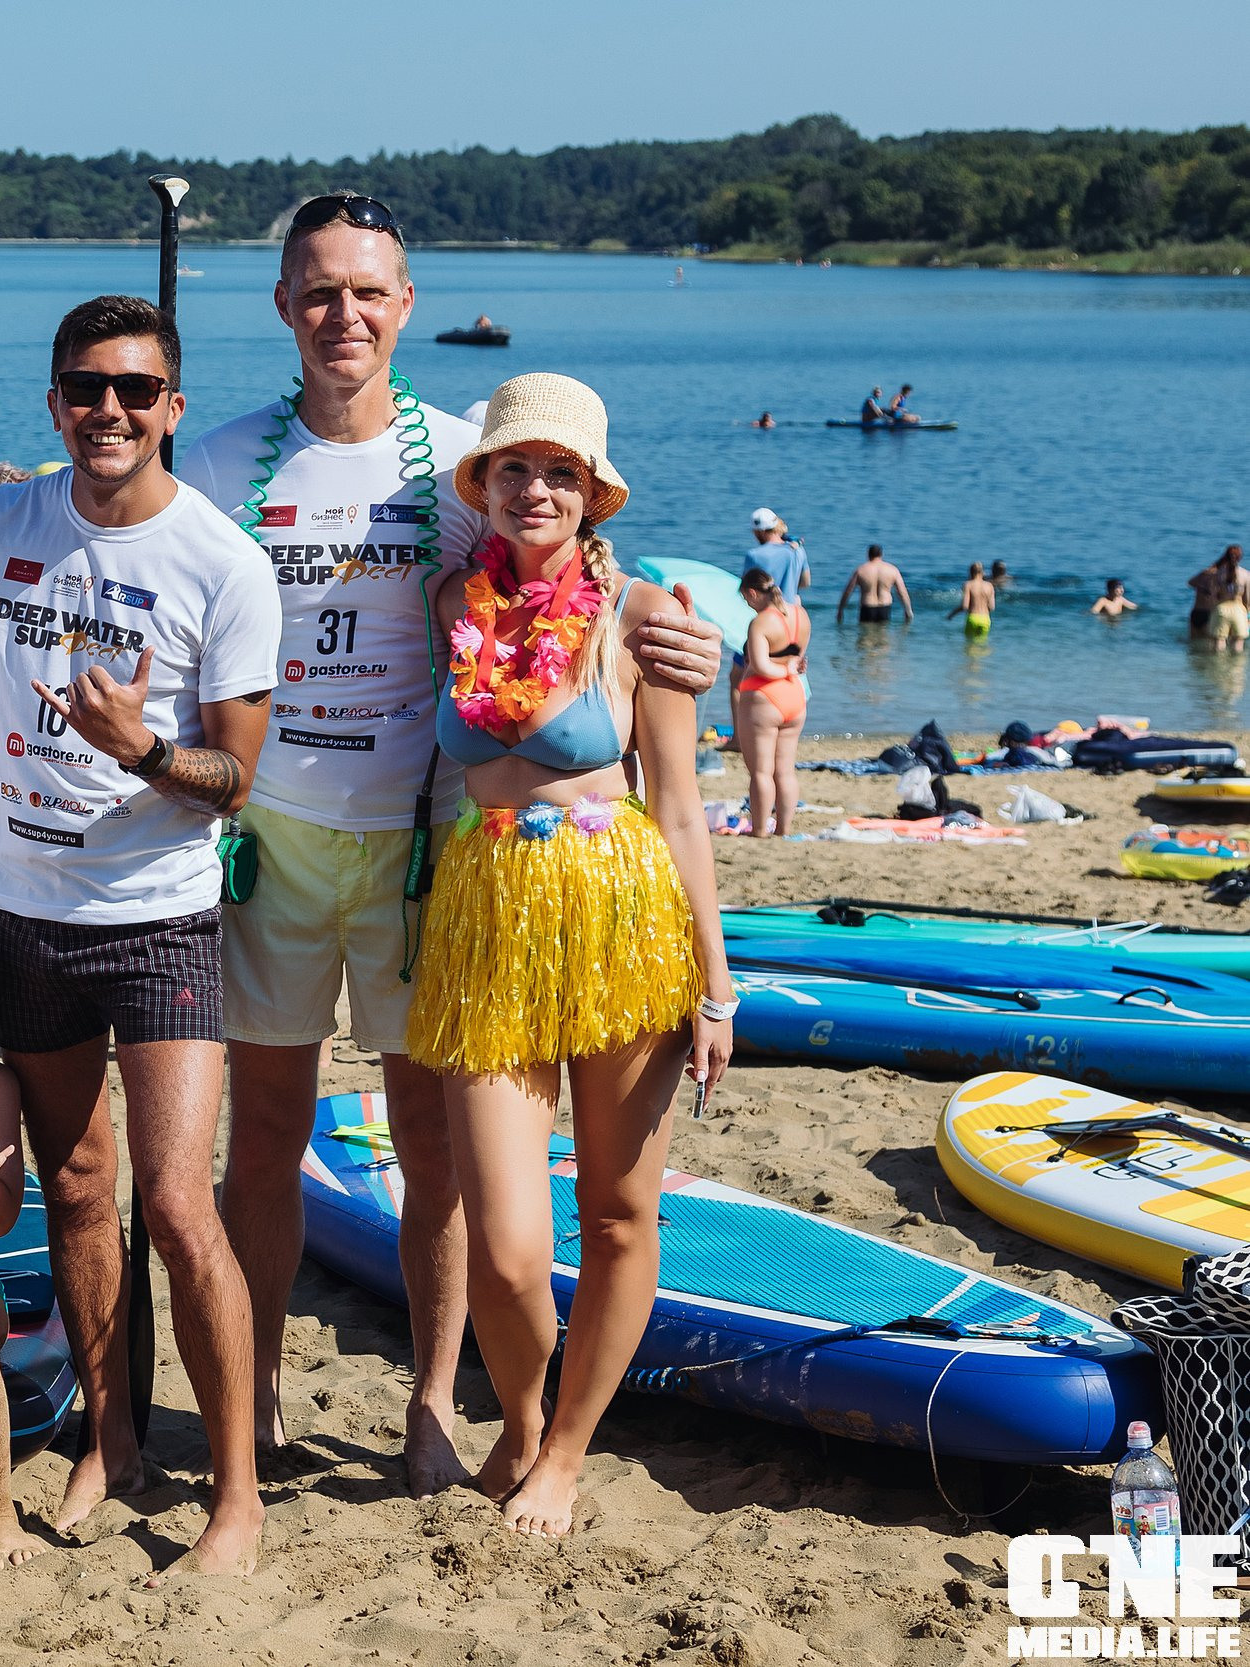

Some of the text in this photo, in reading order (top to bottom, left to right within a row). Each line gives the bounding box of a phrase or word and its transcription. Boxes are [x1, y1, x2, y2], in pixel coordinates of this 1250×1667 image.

[311, 512, 344, 521] бизнес
[53, 575, 81, 589] бизнес
[277, 565, 334, 585] SUP
[14, 625, 61, 651] SUP
[61, 611, 145, 654] WATER
[316, 609, 358, 656] 31
[308, 663, 388, 679] gastore.ru
[285, 732, 366, 747] www.sup4you.ru
[26, 742, 94, 765] gastore.ru
[11, 823, 76, 843] www.sup4you.ru
[407, 835, 424, 892] DAKINE
